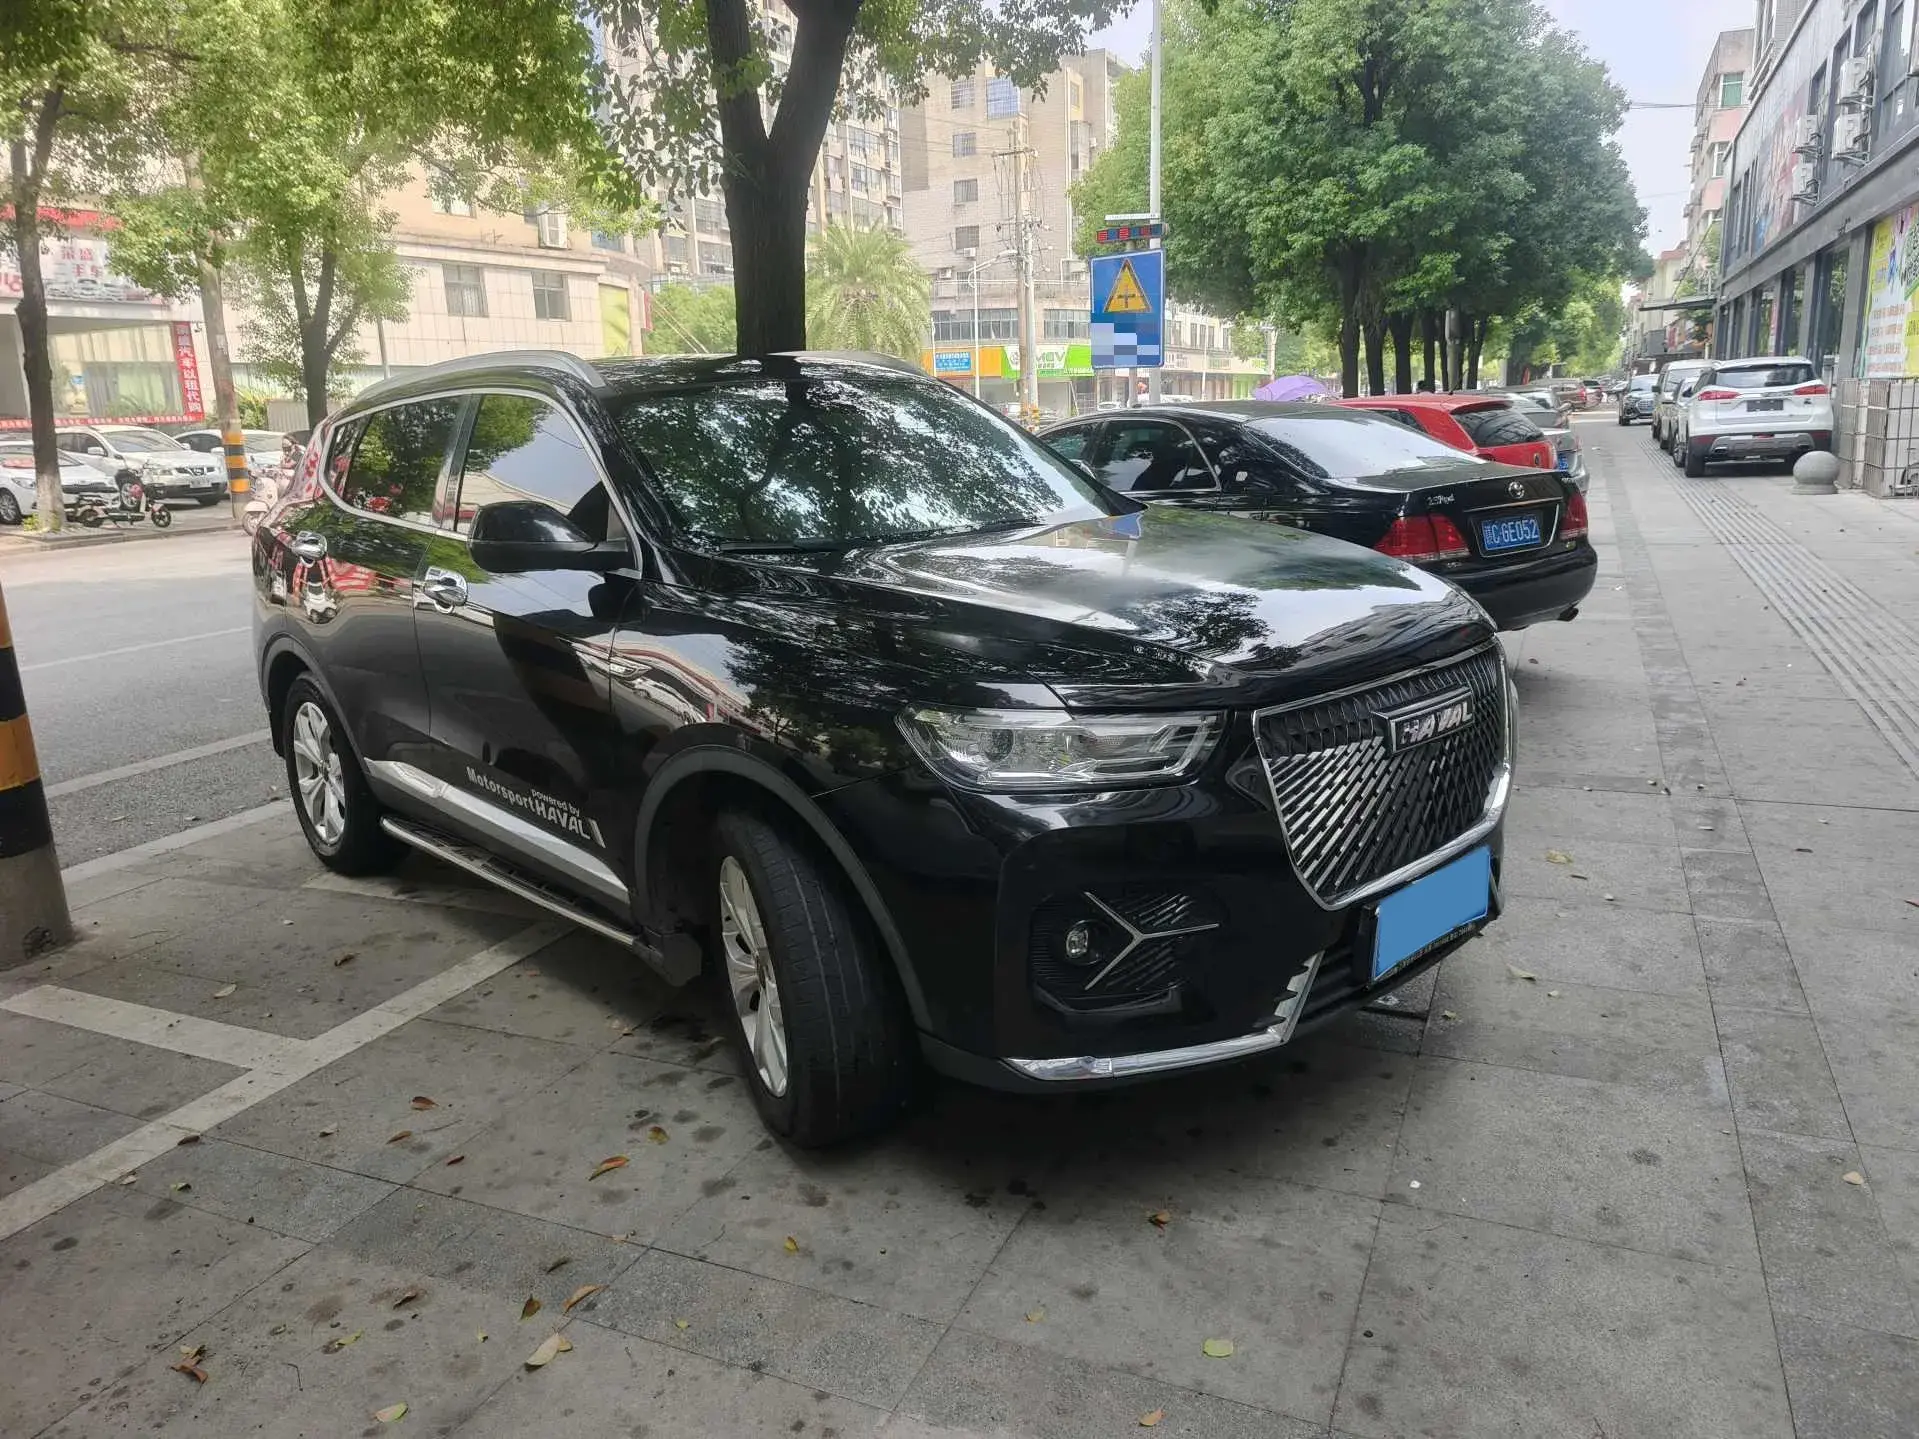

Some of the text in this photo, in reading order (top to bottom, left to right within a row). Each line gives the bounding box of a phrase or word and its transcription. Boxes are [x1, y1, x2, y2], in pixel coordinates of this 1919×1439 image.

[1400, 701, 1473, 744] HAVAL
[530, 788, 580, 817] powered by
